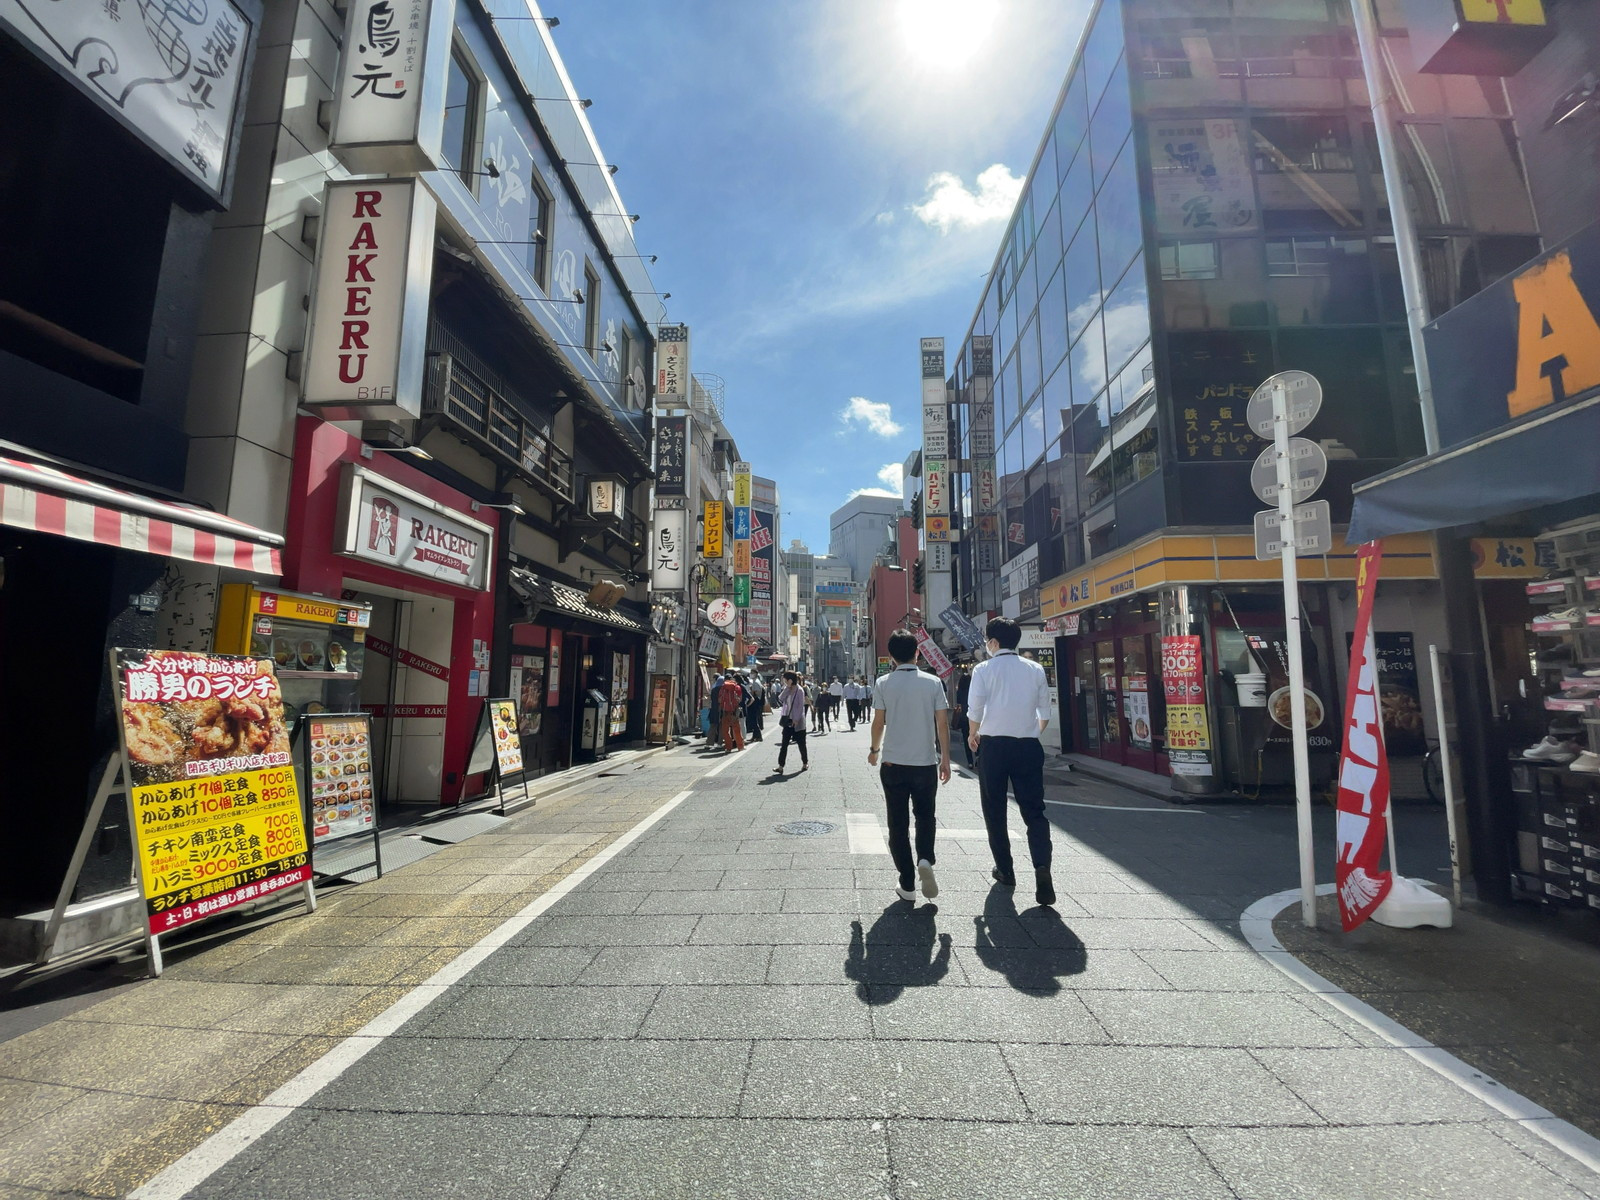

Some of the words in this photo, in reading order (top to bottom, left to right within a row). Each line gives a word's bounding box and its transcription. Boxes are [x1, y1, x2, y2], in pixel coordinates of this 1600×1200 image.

[351, 1, 407, 99] 鳥元
[338, 191, 382, 384] RAKERU
[666, 356, 678, 394] さくら水産
[357, 386, 391, 399] B1F
[1187, 420, 1245, 431] ステー
[1187, 445, 1250, 456] すきや
[409, 517, 478, 560] RAKERU
[928, 531, 947, 539] 松屋
[657, 528, 679, 571] 鳥元
[1495, 541, 1560, 569] 松屋
[1070, 578, 1089, 603] 松屋
[296, 603, 337, 618] RAKERU
[144, 658, 257, 675] 大分中津からあげ
[409, 656, 443, 675] RAKERU
[129, 672, 276, 699] 勝男のランチ
[187, 753, 290, 775] 閉店ギリギリ入店大歓迎!
[139, 776, 250, 807] からあげ7個定食
[258, 770, 293, 786] 700円
[142, 791, 258, 825] からあげ10個定食
[261, 786, 295, 802] 850円
[147, 823, 246, 857] チキン南蛮定食
[264, 812, 299, 829] 700円
[188, 835, 262, 864] ミックス定食
[266, 827, 301, 844] 800円
[153, 850, 264, 891] ハラミ300g定食
[264, 840, 304, 859] 1000円
